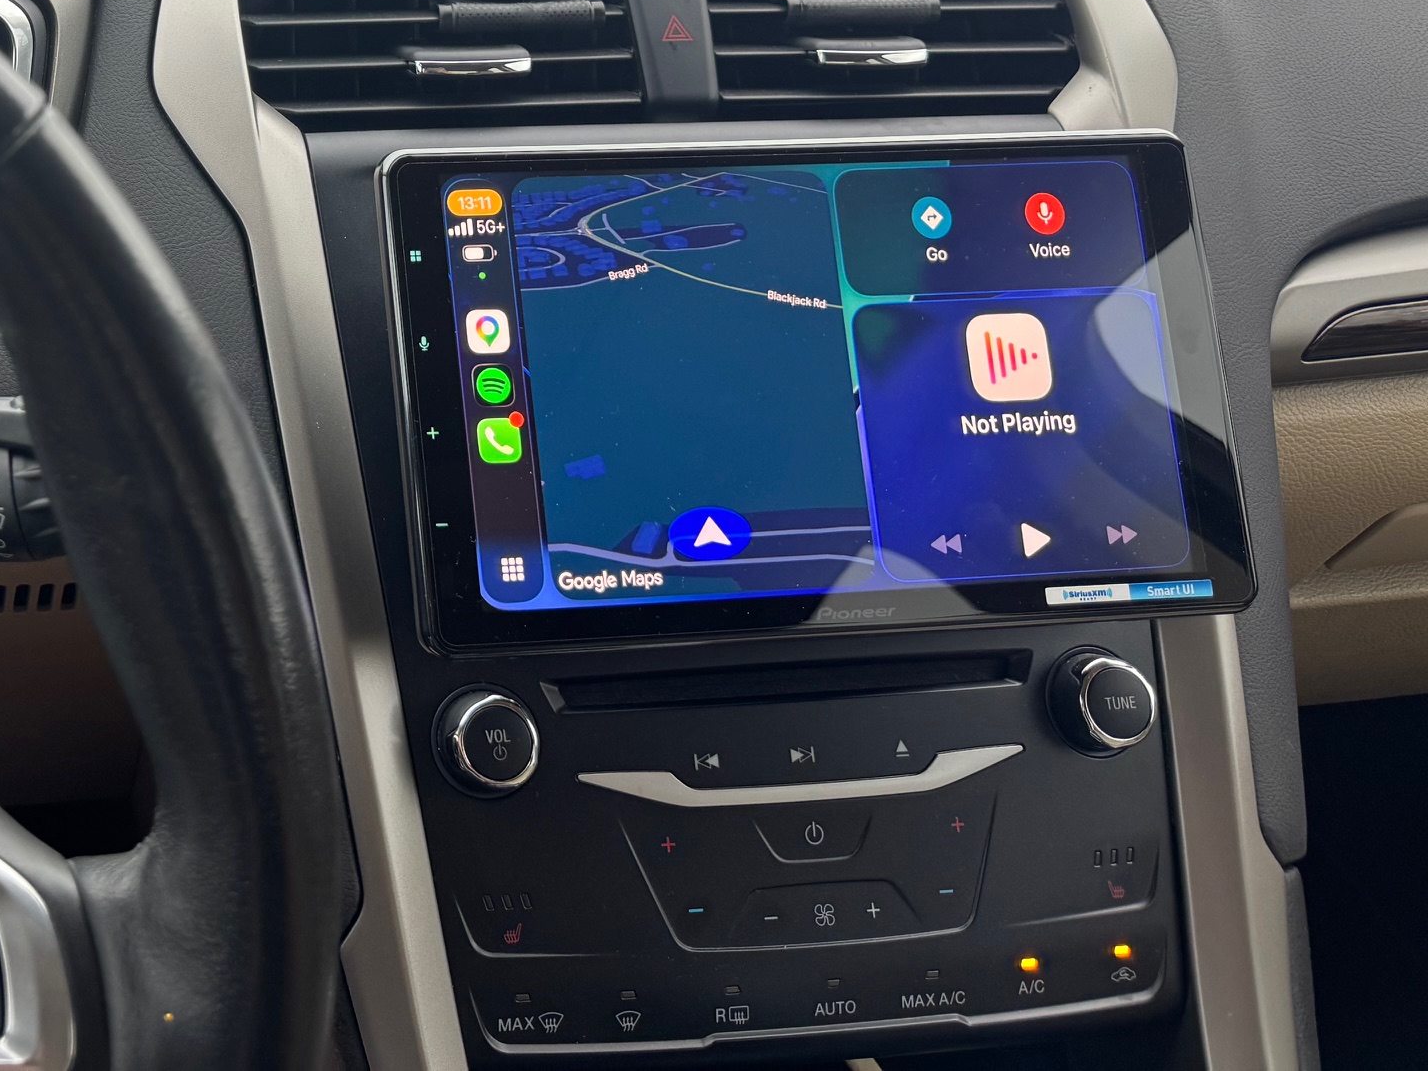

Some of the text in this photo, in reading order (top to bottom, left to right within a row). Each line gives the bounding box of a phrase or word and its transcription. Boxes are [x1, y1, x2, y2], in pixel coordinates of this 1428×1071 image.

[457, 195, 493, 211] 13:11
[476, 220, 506, 235] 5G+
[926, 247, 948, 261] Go
[1029, 242, 1071, 258] Voice
[608, 263, 649, 281] Bragg Rd
[767, 290, 826, 309] Blackjack Rd
[961, 411, 1077, 436] Not Playing
[558, 569, 664, 593] Google Maps
[1146, 583, 1195, 597] Smart UI
[816, 607, 896, 620] Pioneer
[1104, 696, 1137, 710] TUNE
[485, 729, 511, 744] VOL
[1018, 980, 1045, 995] A/C
[901, 991, 966, 1009] MAX A/C
[715, 1008, 726, 1023] R
[814, 1000, 857, 1017] AUTO
[498, 1016, 535, 1032] MAX
